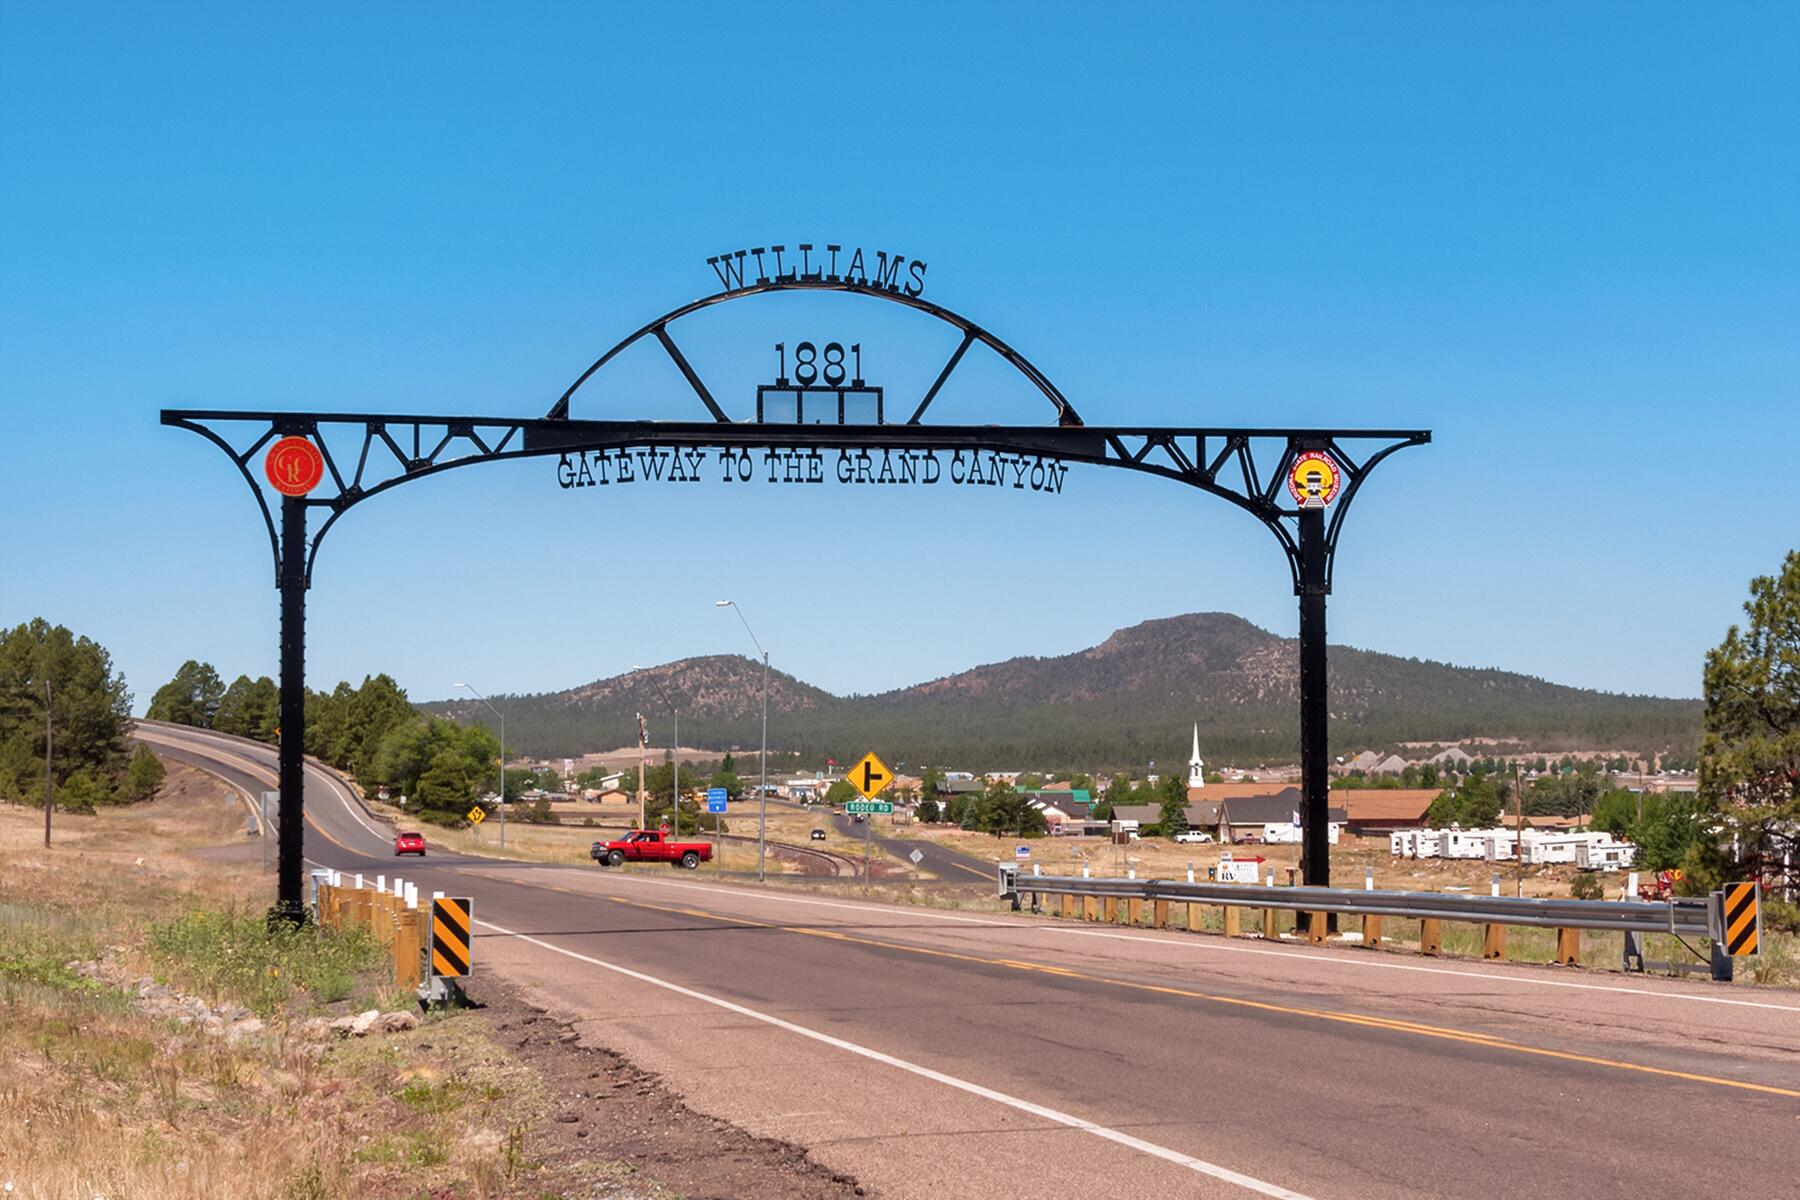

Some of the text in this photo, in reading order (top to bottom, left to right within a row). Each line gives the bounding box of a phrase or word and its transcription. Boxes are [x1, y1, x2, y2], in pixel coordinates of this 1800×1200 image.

[706, 244, 927, 297] WILLIAMS
[775, 341, 866, 387] 1881
[557, 451, 1069, 494] GATEWAY TO THE GRAND CANYON
[1325, 473, 1340, 502] MUSEUM
[850, 803, 889, 812] RODEO RD
